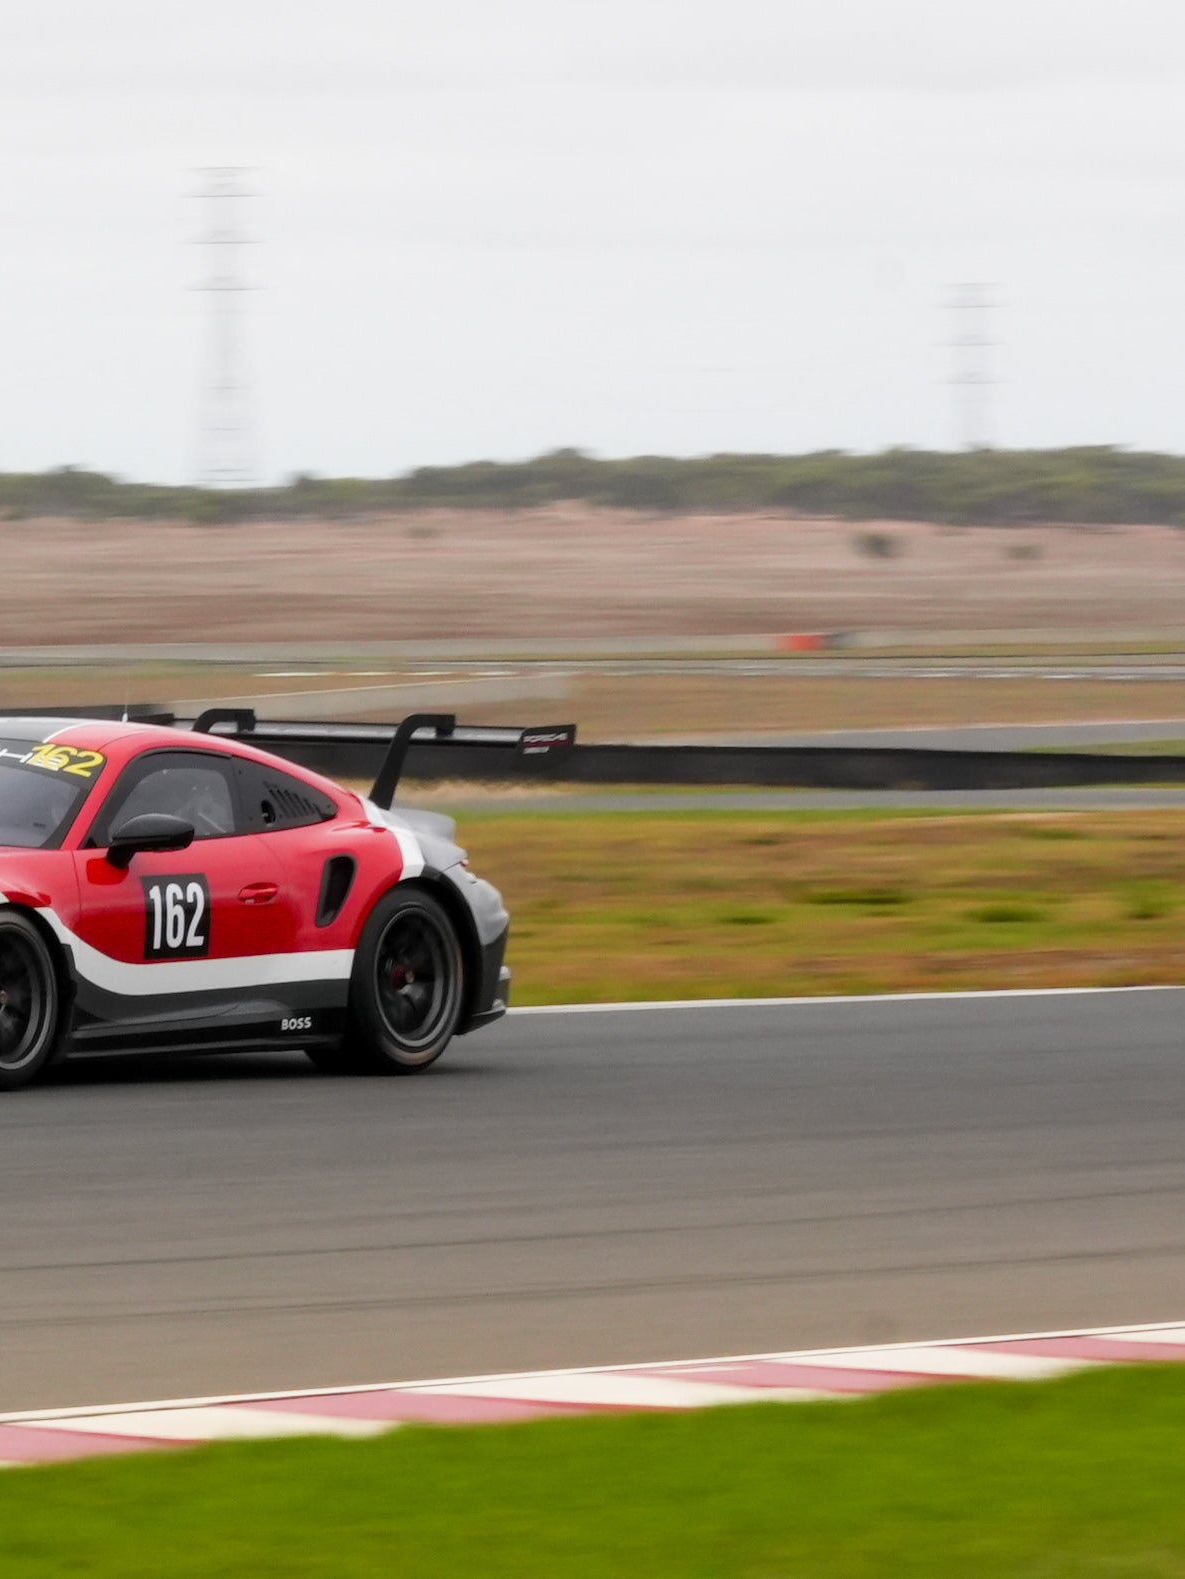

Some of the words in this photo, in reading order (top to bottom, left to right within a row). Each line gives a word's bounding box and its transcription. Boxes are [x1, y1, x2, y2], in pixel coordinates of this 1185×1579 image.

[32, 742, 104, 778] 162
[149, 882, 205, 950] 162
[281, 1016, 312, 1031] BOSS
